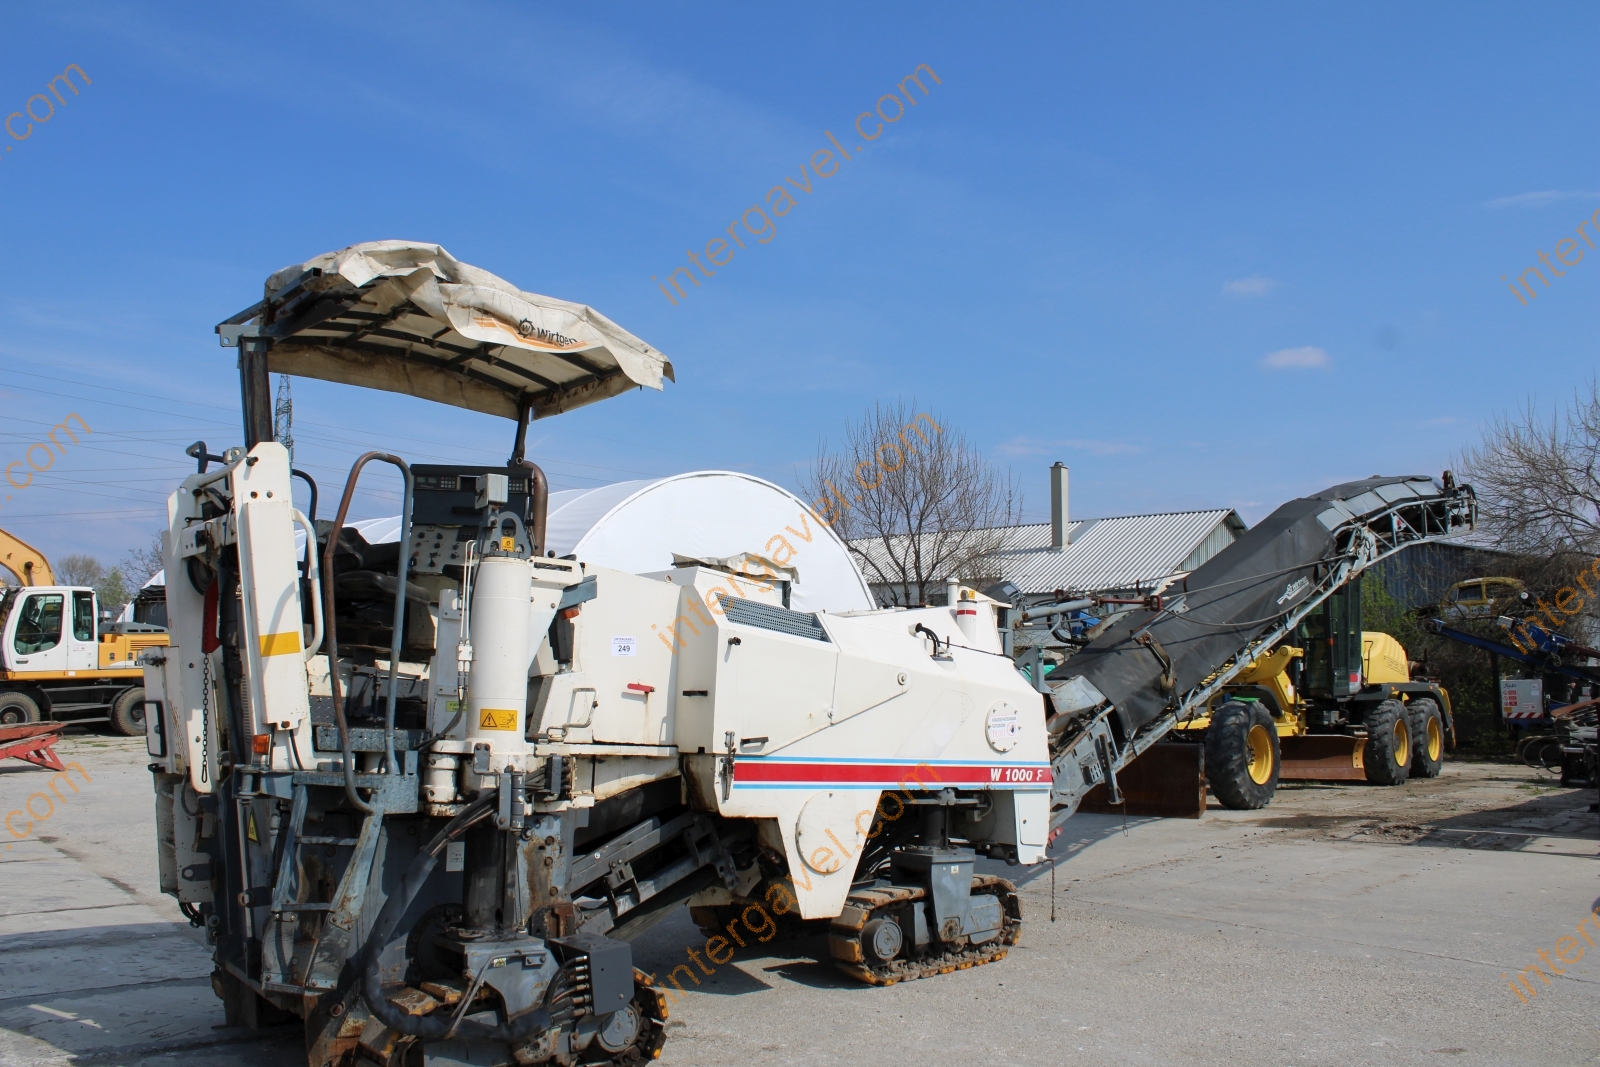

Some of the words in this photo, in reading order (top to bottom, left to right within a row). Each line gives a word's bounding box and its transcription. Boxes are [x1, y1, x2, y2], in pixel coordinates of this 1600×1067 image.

[618, 644, 631, 652] 249
[990, 768, 1002, 782] W
[1005, 768, 1033, 782] 1000
[1036, 769, 1044, 782] F
